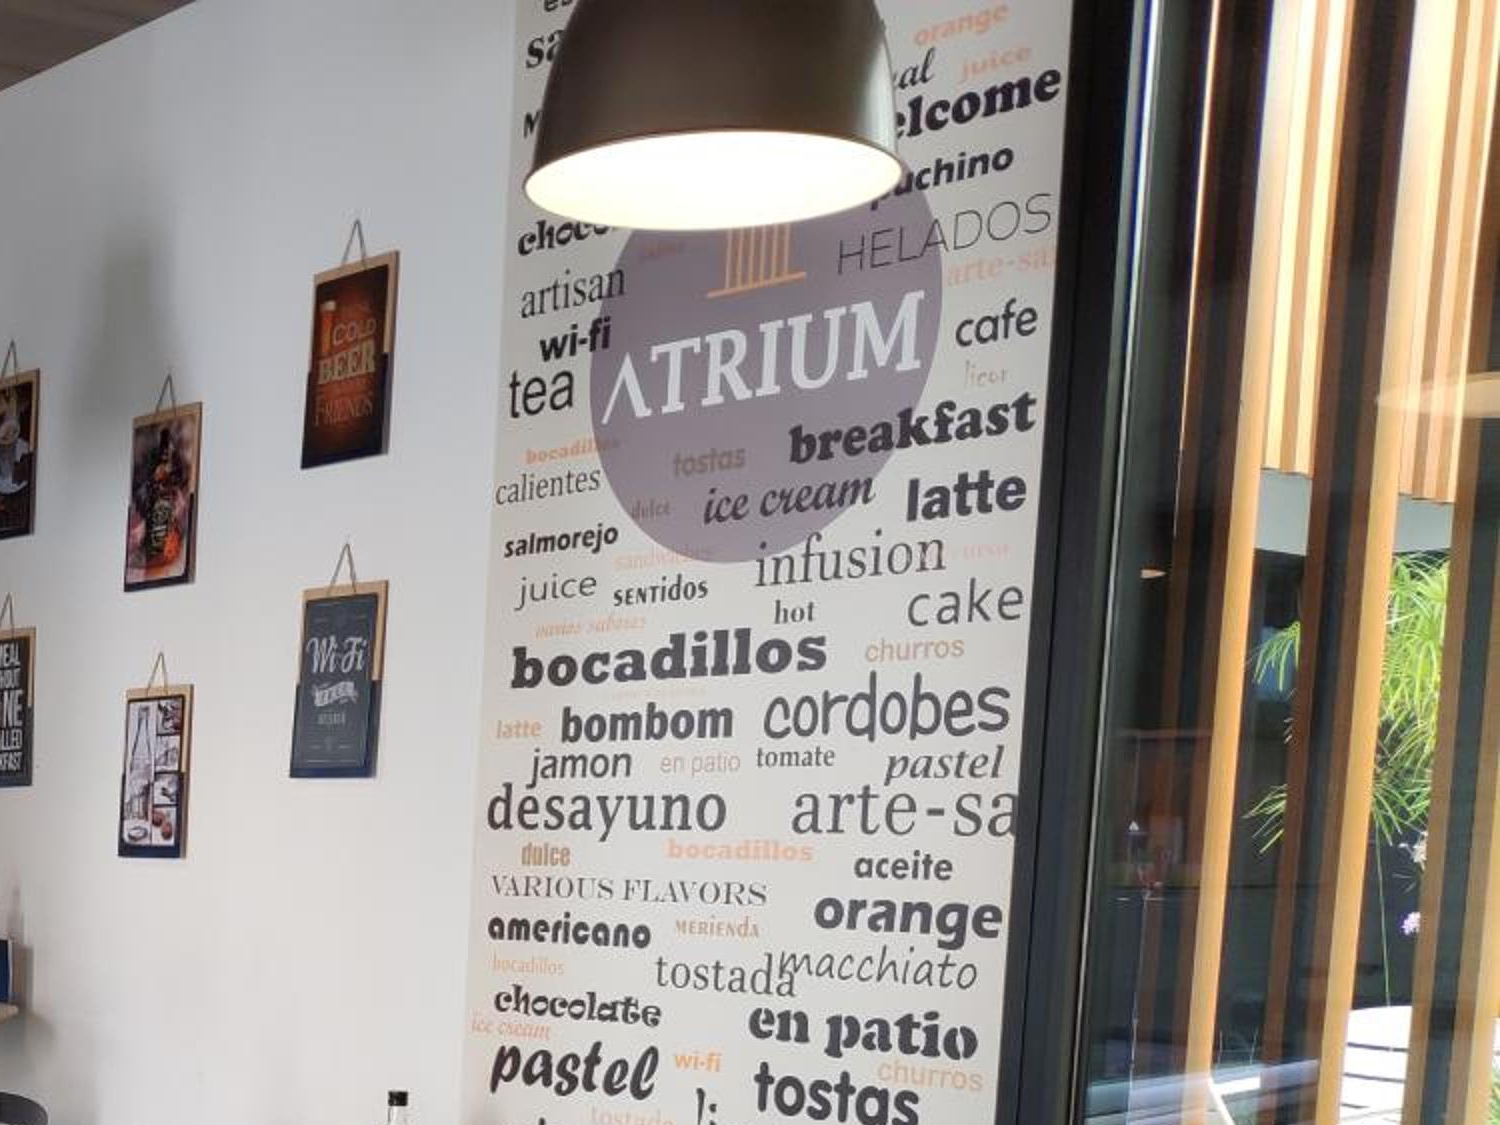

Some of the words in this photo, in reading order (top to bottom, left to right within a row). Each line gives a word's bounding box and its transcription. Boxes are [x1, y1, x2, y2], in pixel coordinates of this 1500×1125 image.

[914, 4, 1012, 46] orange
[838, 193, 1052, 275] HELADOS
[520, 265, 626, 319] artisan
[332, 318, 376, 347] COLD
[539, 316, 611, 362] wi-fi
[955, 298, 1038, 347] cafe
[318, 340, 376, 384] BEER
[602, 289, 925, 425] ATRIUM
[508, 370, 574, 419] tea
[788, 391, 1037, 464] breakfast
[674, 448, 746, 478] tostas
[495, 469, 601, 506] calientes
[703, 487, 750, 525] ice
[760, 473, 876, 517] cream
[905, 468, 1027, 522] latte
[503, 523, 618, 559] salmorejo
[755, 528, 947, 587] infusion
[514, 573, 597, 612] juice
[773, 600, 815, 624] hot
[907, 577, 1024, 627] cake
[510, 627, 828, 689] bocadillos
[865, 639, 964, 662] churros
[561, 702, 734, 743] bombom
[763, 670, 1011, 743] cordobes
[497, 720, 542, 739] latte
[526, 748, 632, 789] jamon
[660, 754, 683, 773] en
[691, 751, 741, 777] patio
[756, 746, 836, 769] tomate
[884, 744, 1005, 787] pastel
[487, 782, 727, 842] desayuno
[521, 842, 571, 866] dulce
[667, 838, 814, 863] bocadillos
[854, 850, 953, 882] aceite
[492, 875, 614, 899] VARIOUS
[623, 878, 768, 906] FLAVORS
[488, 911, 651, 949] americano
[814, 897, 1003, 950] orange
[656, 953, 796, 997] tostada
[779, 945, 978, 990] macchiato
[494, 984, 662, 1028] chocolate
[748, 1007, 810, 1044] en
[824, 1010, 978, 1060] patio
[489, 1040, 659, 1101] pastel
[675, 1051, 722, 1073] wi-fi
[877, 1058, 984, 1092] churros
